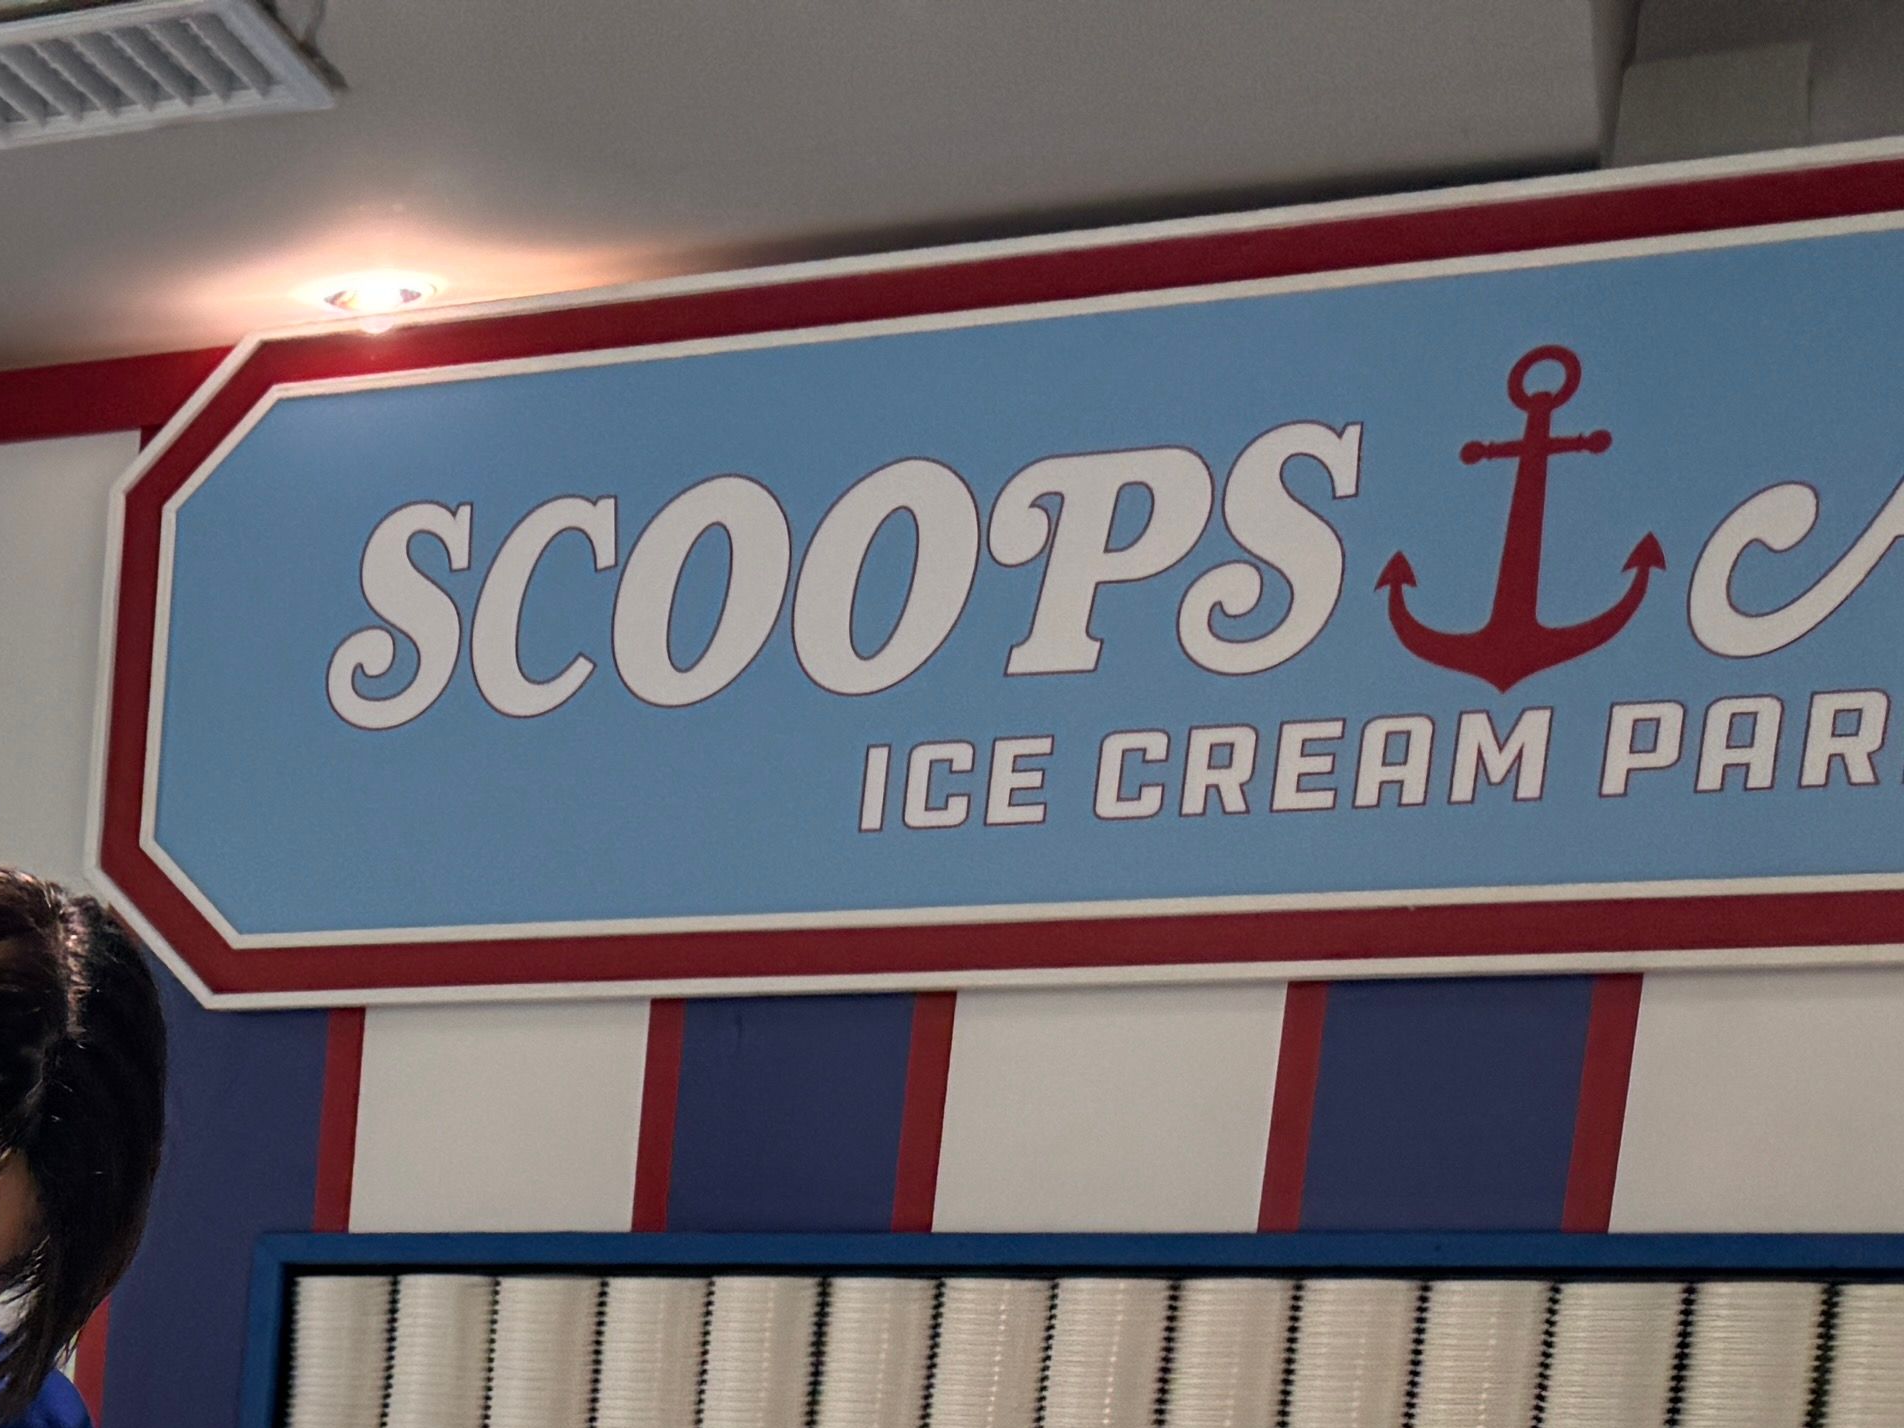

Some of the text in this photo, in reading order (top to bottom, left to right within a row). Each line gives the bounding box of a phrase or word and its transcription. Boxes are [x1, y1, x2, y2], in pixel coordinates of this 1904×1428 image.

[325, 420, 1363, 730] SCOOPS
[858, 687, 1904, 833] ICE CREAM PAR
